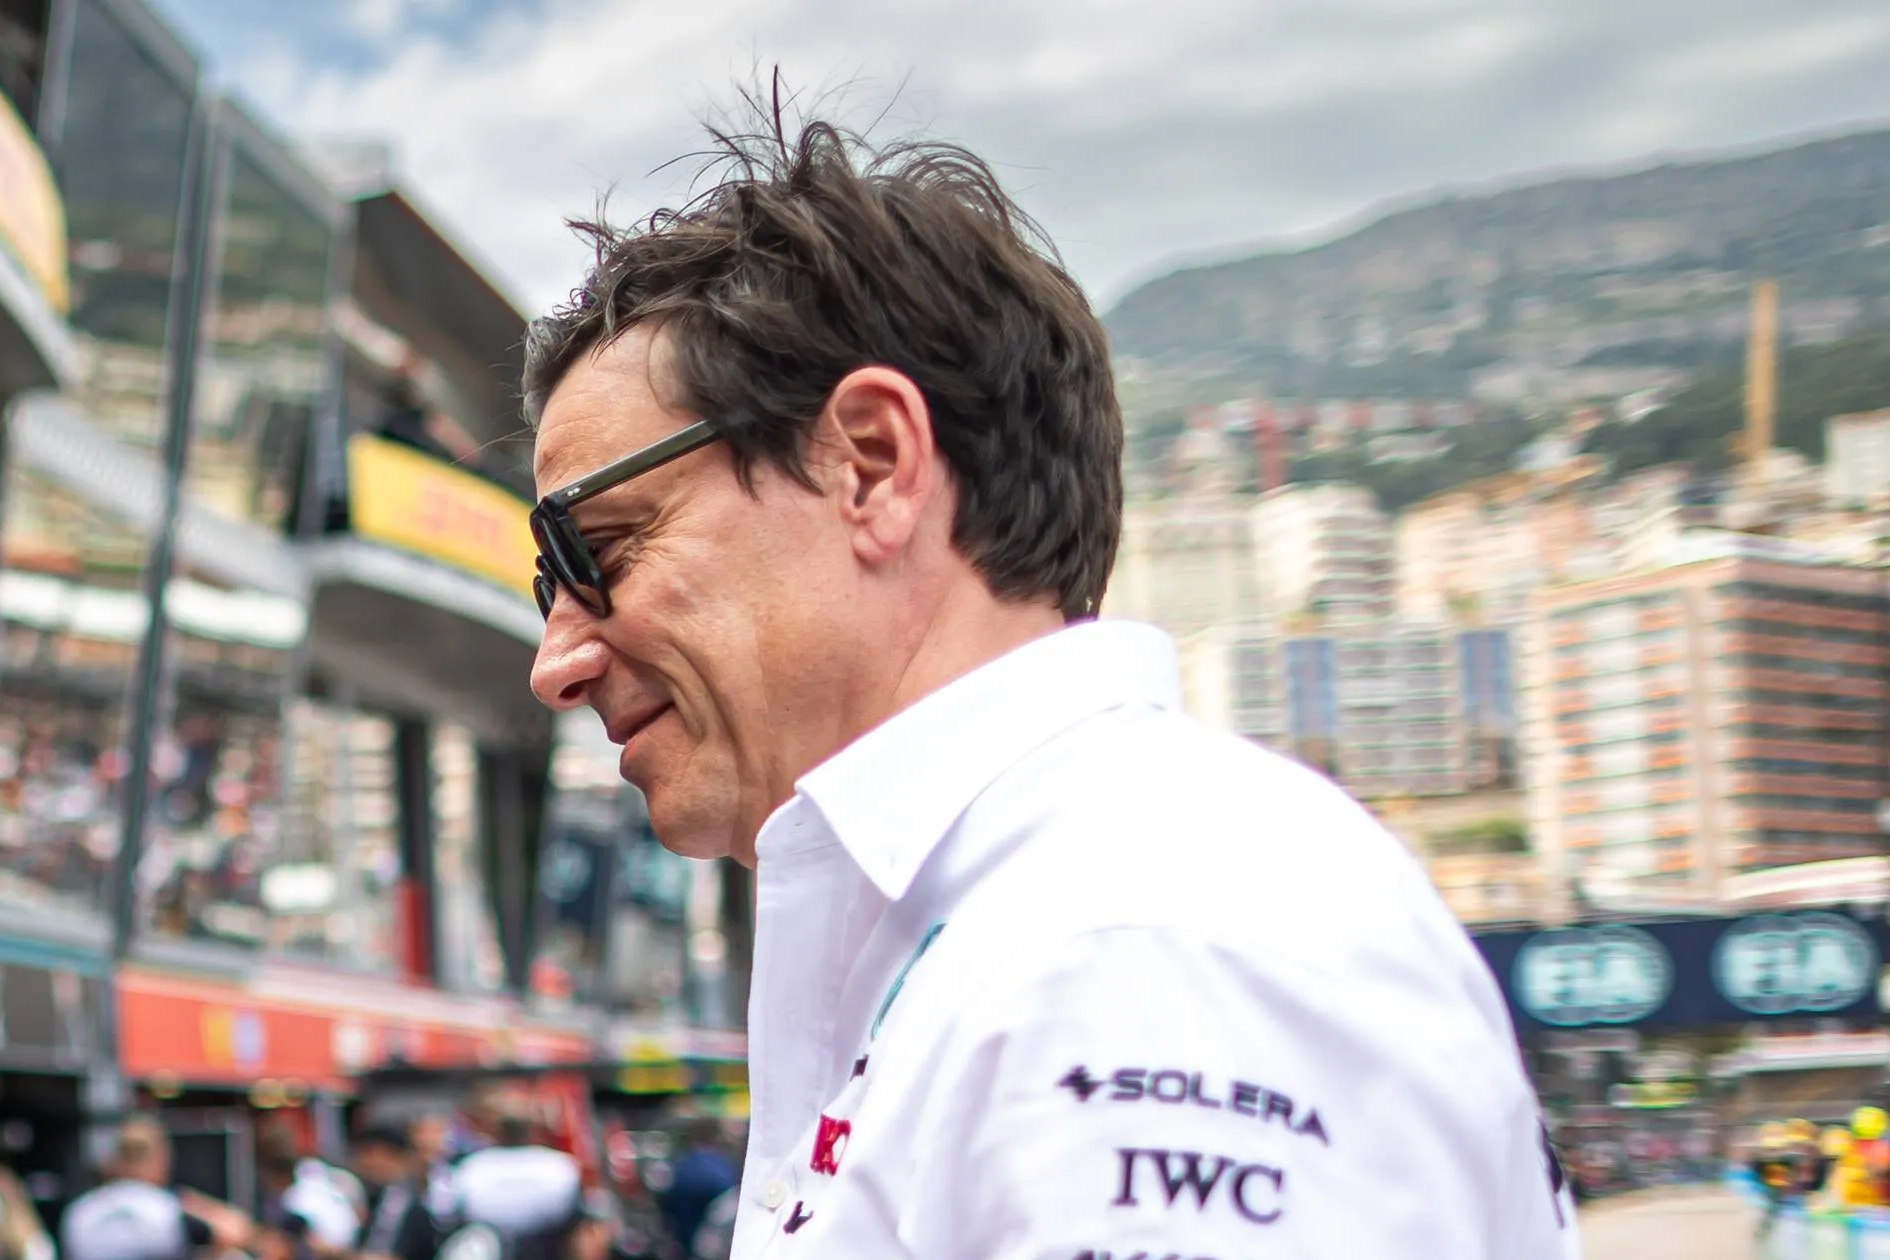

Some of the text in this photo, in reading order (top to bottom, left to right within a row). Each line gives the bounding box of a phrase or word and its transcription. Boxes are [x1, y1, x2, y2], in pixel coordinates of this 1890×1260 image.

[1525, 943, 1652, 1006] FIA
[1724, 931, 1856, 996] FIA
[1109, 1067, 1331, 1148] SOLERA
[1111, 1146, 1285, 1225] IWC
